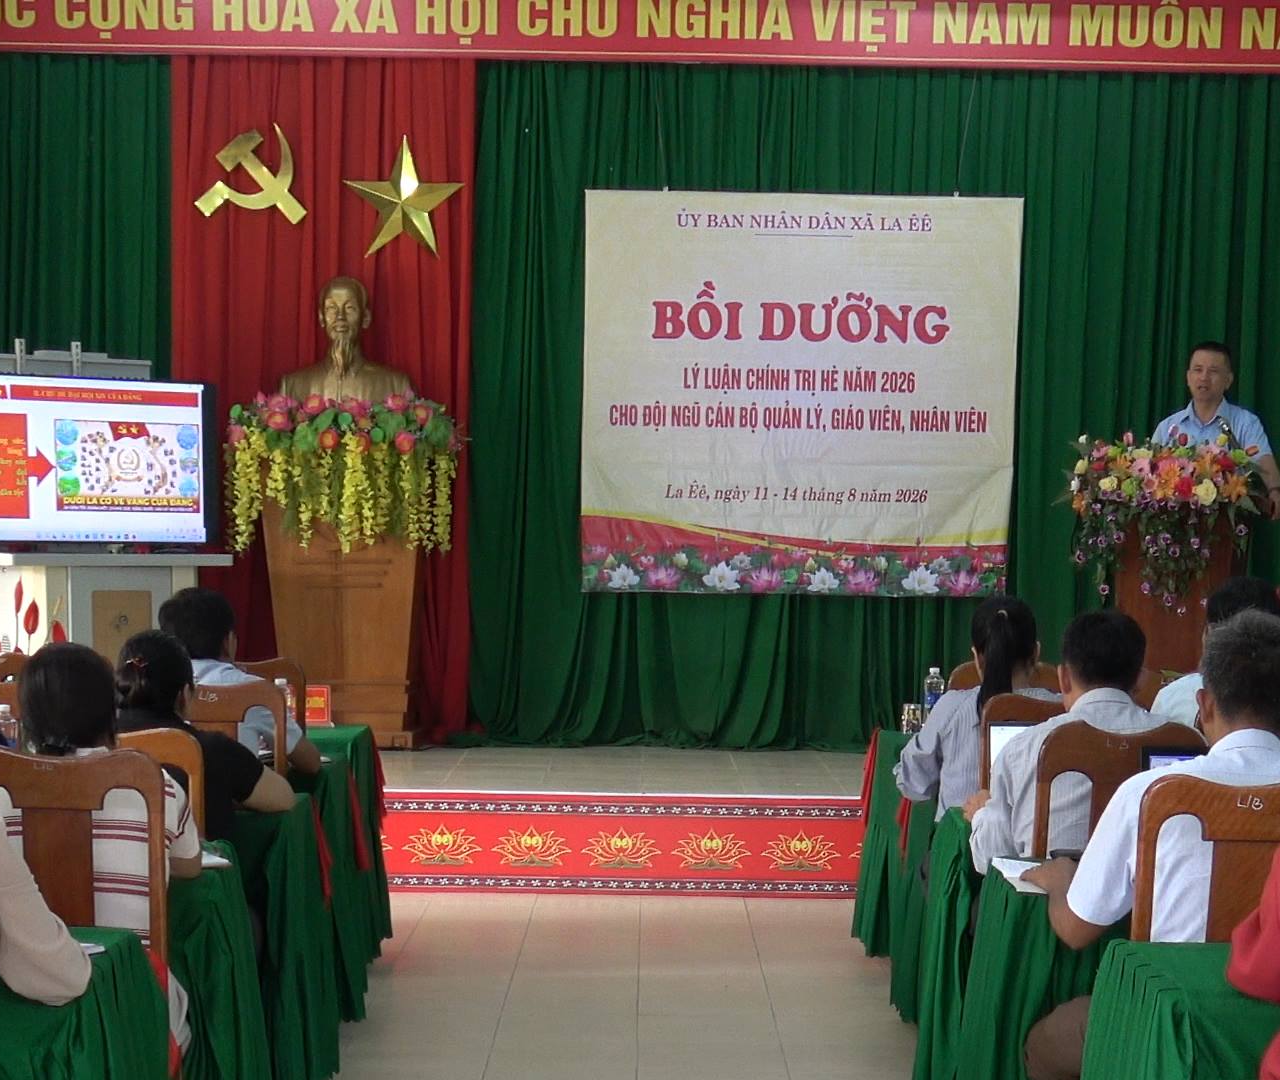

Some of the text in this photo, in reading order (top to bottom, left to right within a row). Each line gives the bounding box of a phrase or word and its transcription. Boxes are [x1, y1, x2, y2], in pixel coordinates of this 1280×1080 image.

[932, 2, 1051, 46] NAM
[677, 209, 933, 232] ỦY BAN NHÂN DÂN XÃ LA ÊÊ
[652, 280, 950, 345] BỒI DƯỠNG
[683, 362, 916, 397] LÝ LUẬN CHÍNH TRỊ HÈ NĂM 2026
[609, 400, 987, 434] CHO ĐỘI NGŨ CÁN BỘ QUẢN LÝ, GIÁO VIÊN, NHÂN VIÊN
[665, 484, 683, 499] La
[714, 485, 750, 503] ngày
[754, 486, 769, 500] 11
[783, 486, 798, 501] 14
[802, 487, 846, 505] tháng
[847, 488, 857, 502] 8
[860, 488, 892, 503] năm
[895, 488, 928, 503] 2026
